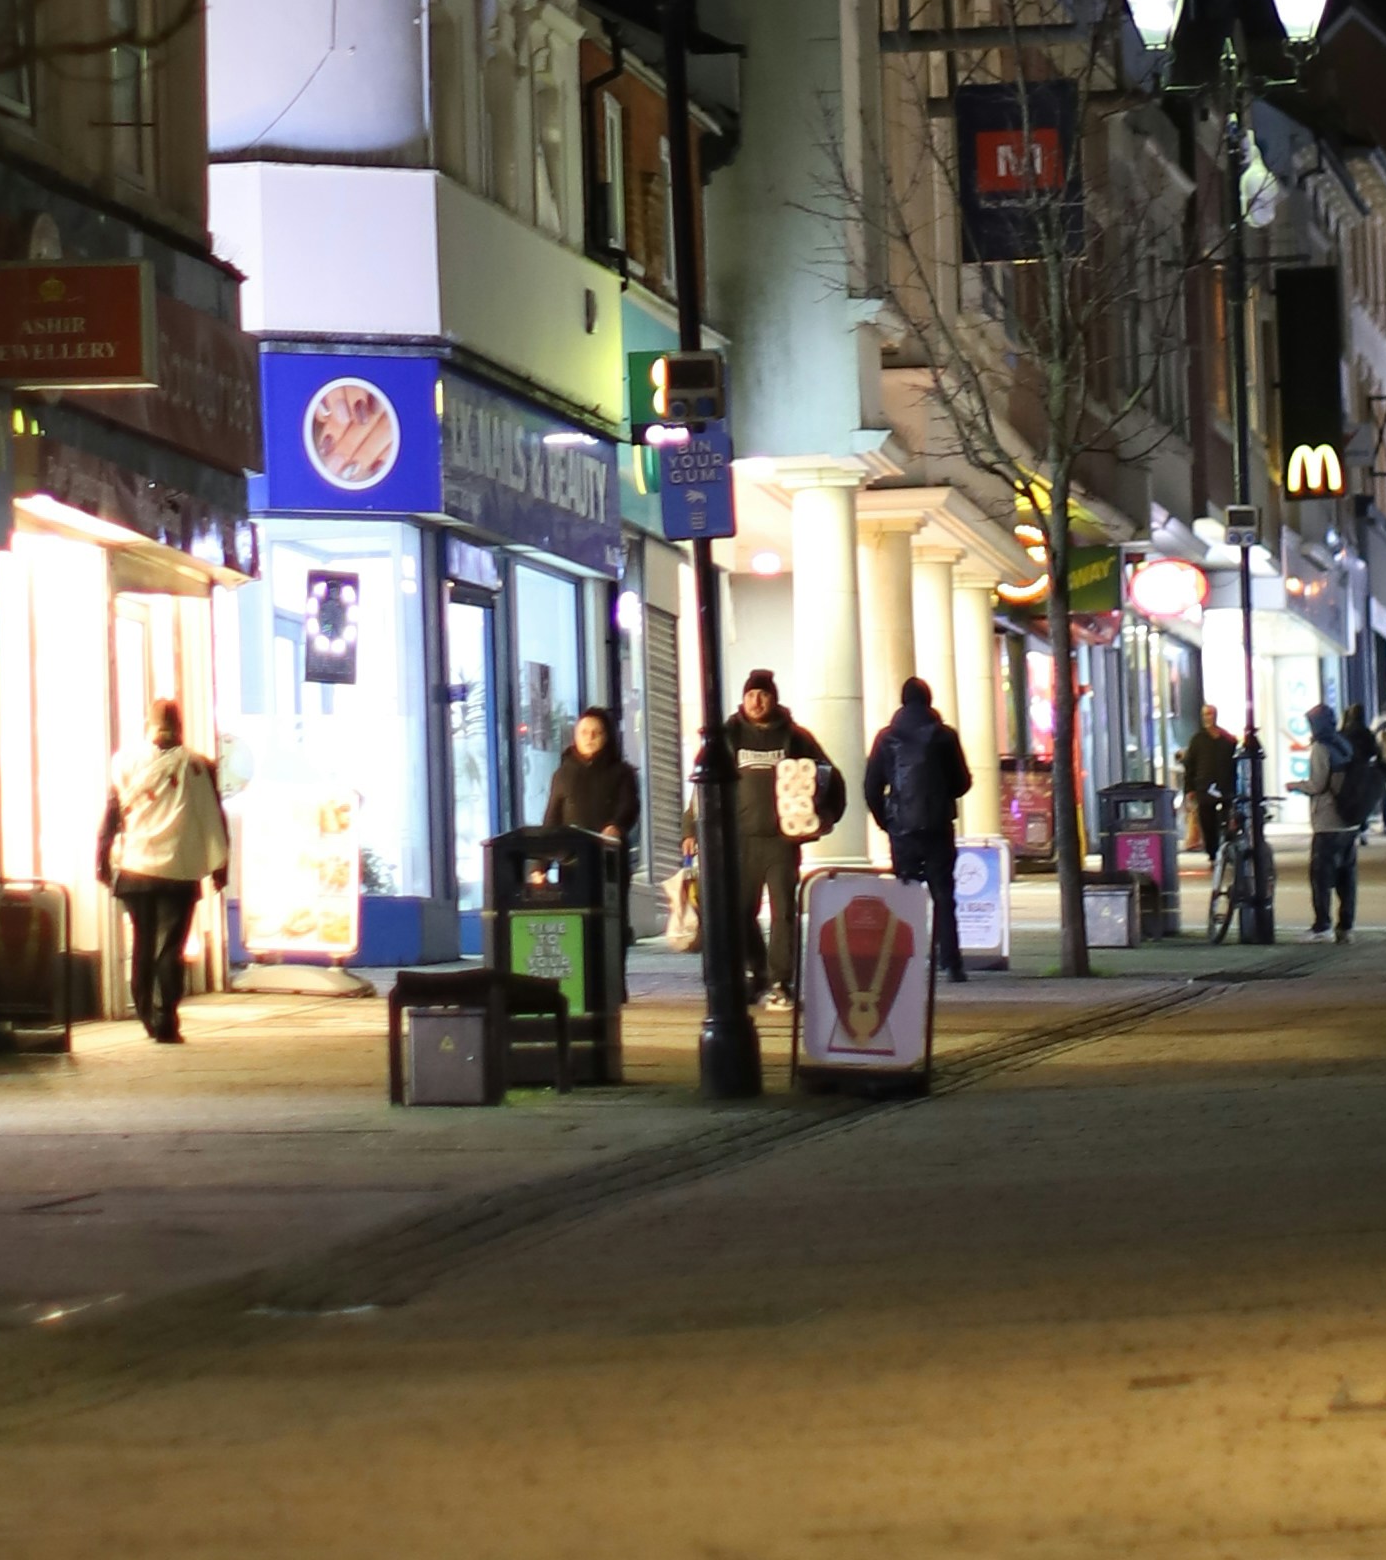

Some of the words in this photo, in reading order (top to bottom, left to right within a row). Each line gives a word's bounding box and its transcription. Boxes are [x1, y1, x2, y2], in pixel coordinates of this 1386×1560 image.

[678, 440, 711, 454] BIN
[669, 453, 723, 469] YOUR
[547, 441, 608, 524] BEAUTY
